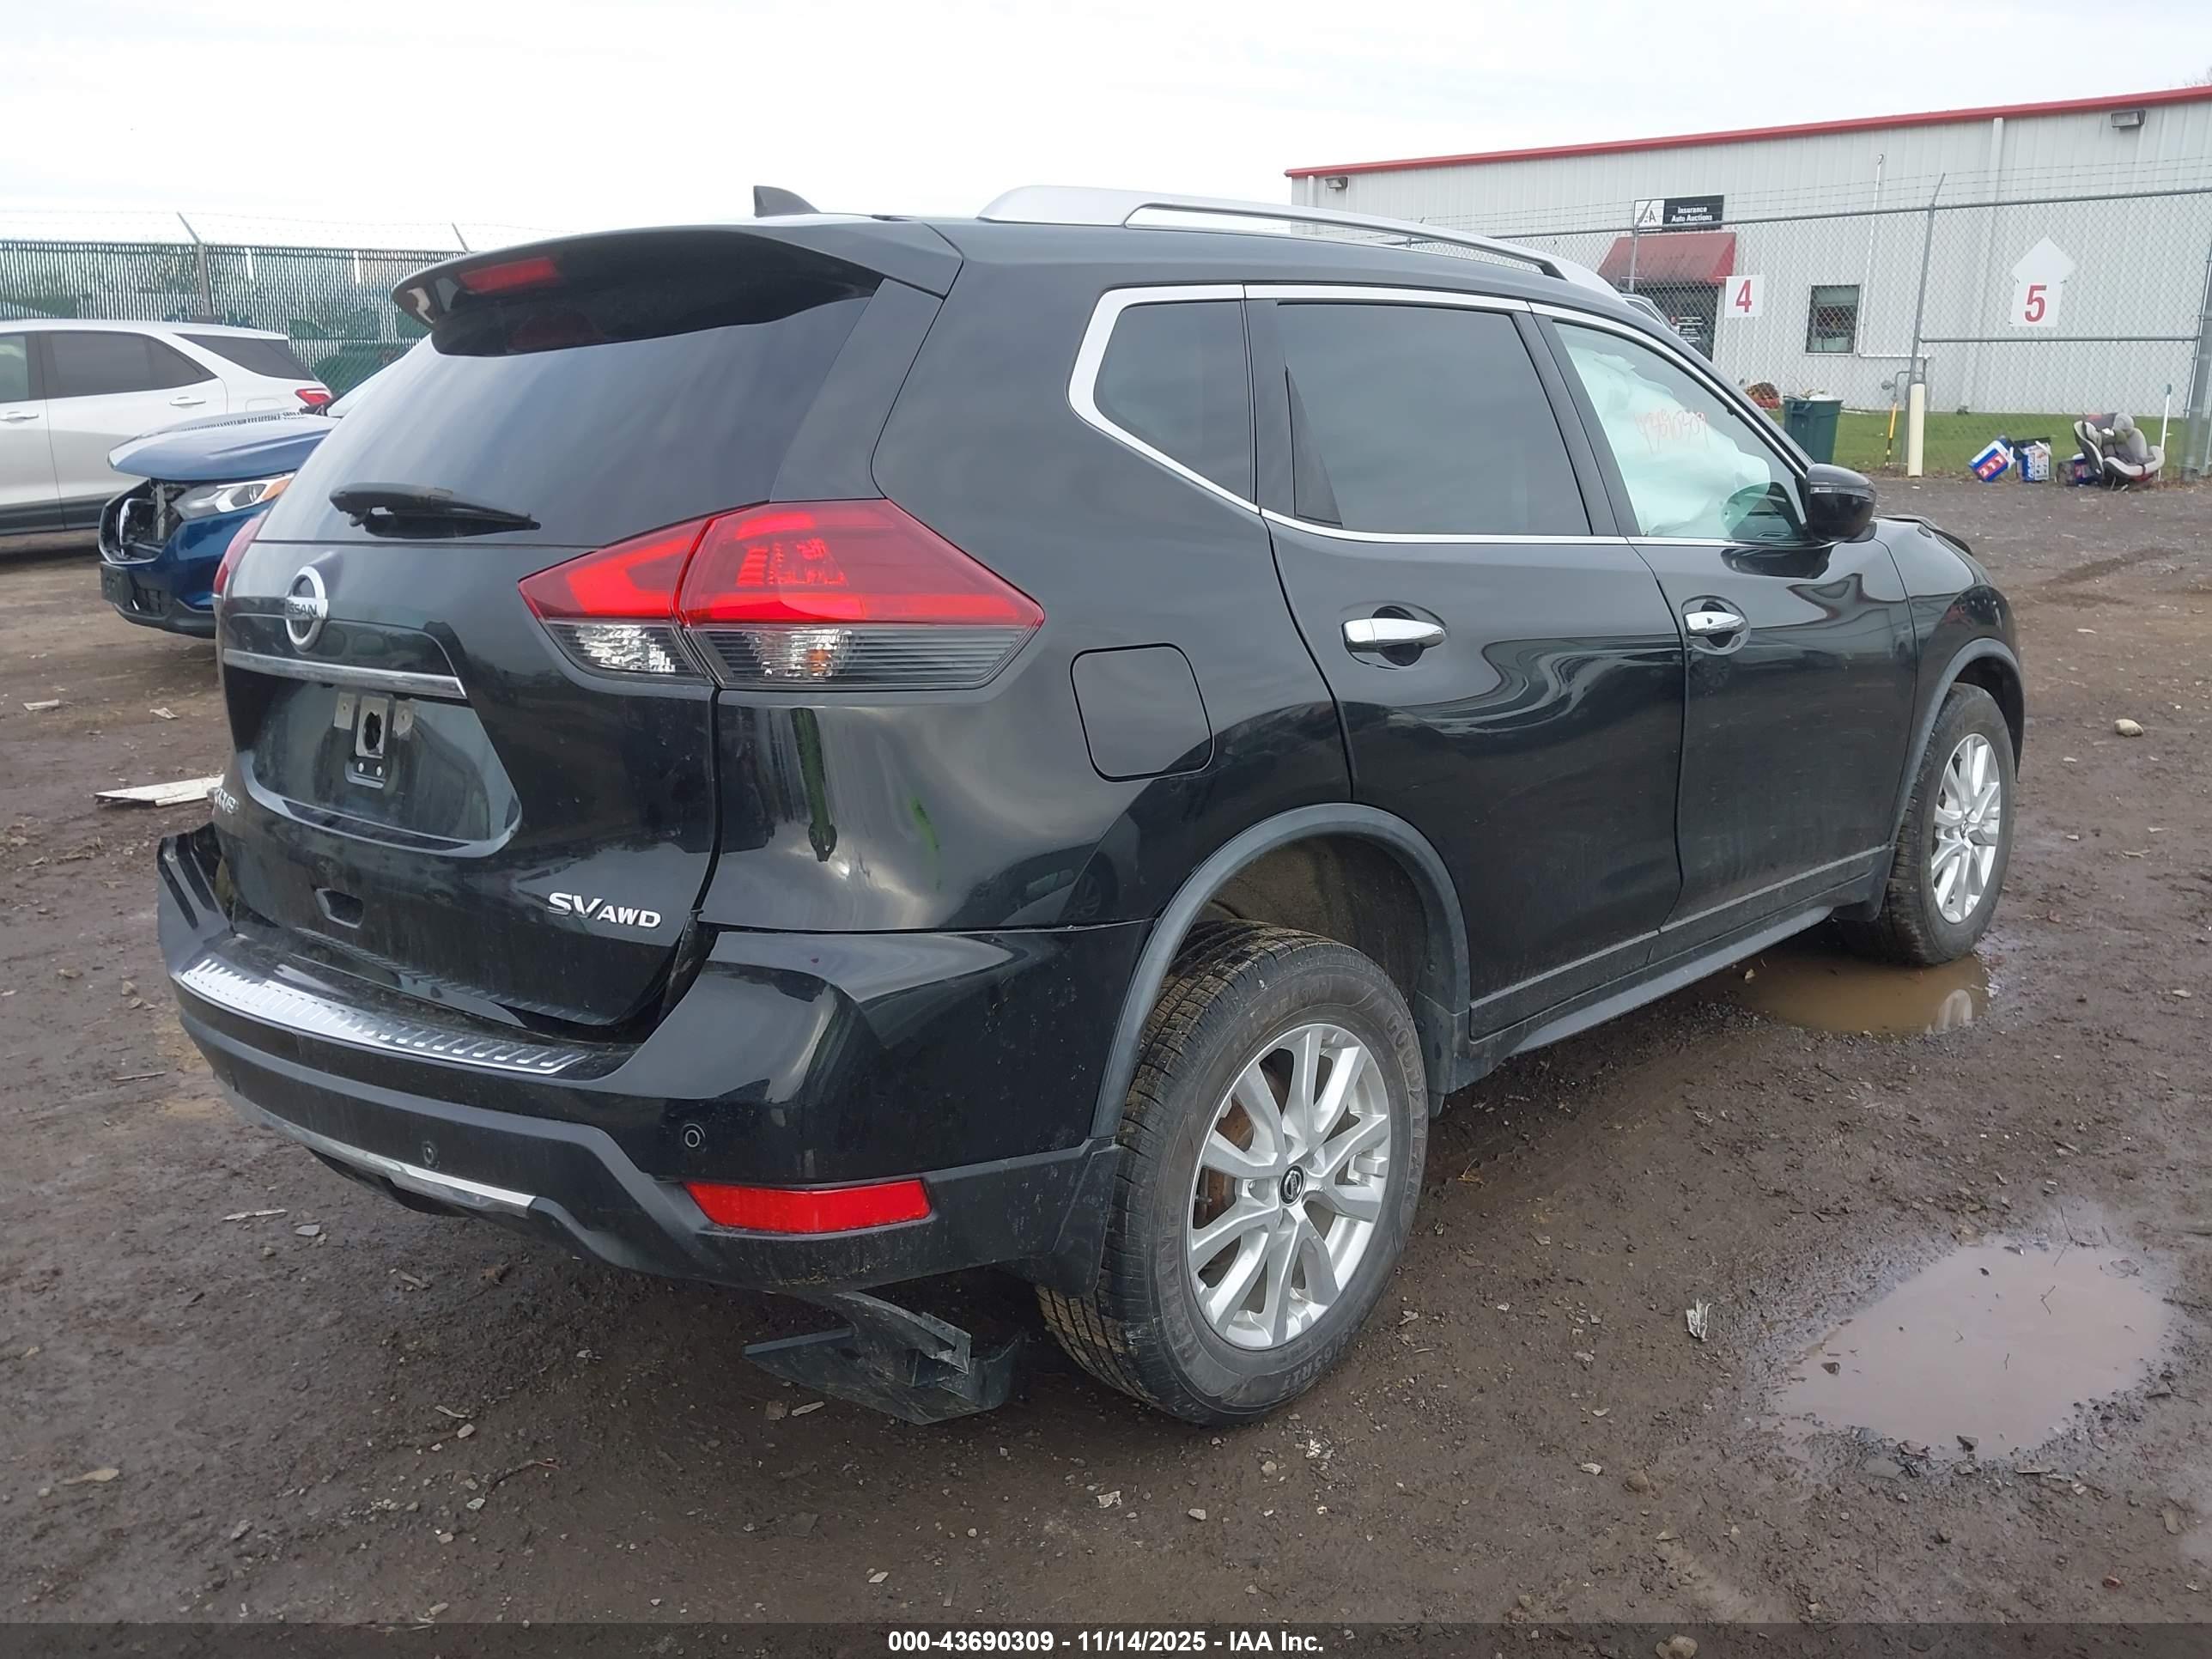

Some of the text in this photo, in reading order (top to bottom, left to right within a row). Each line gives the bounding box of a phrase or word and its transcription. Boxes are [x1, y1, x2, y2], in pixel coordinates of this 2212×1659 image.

[1671, 213, 1713, 223] Auto Auctions
[1677, 205, 1708, 214] Insurance
[1735, 279, 1753, 313] 4
[2025, 284, 2048, 323] 5
[547, 892, 662, 928] SV AWD
